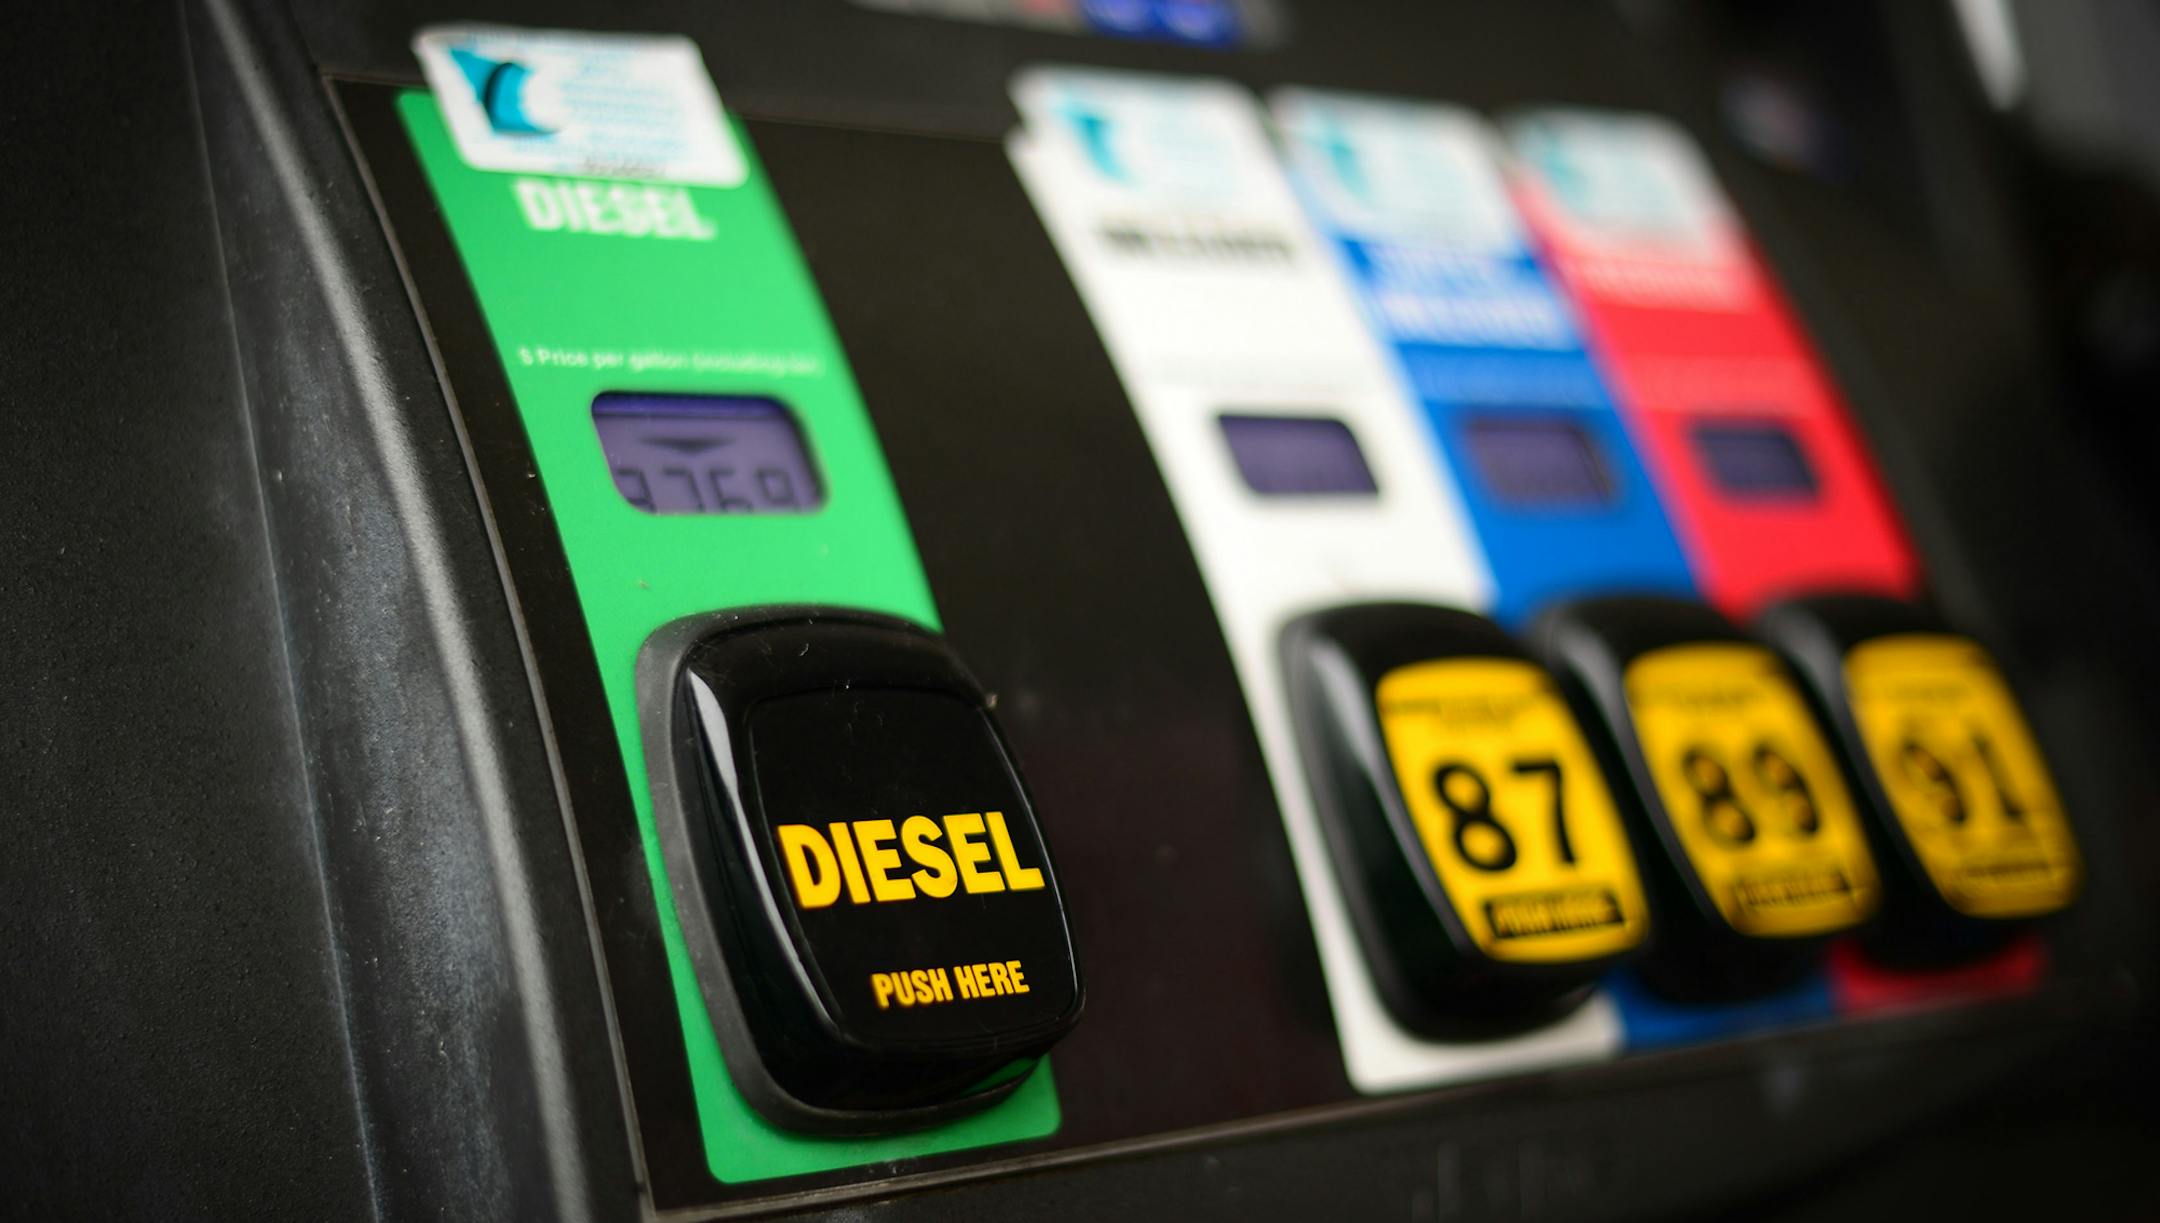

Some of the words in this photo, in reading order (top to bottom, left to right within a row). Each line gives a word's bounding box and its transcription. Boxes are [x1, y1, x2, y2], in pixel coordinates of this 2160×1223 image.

[513, 178, 717, 241] DIESEL
[536, 347, 589, 368] Price
[592, 352, 625, 371] per
[1432, 760, 1578, 873] 87
[1680, 738, 1821, 852] 89
[1898, 728, 2024, 830] 91
[777, 811, 1046, 909] DIESEL
[870, 967, 954, 1011] PUSH
[953, 959, 1030, 1000] HERE
